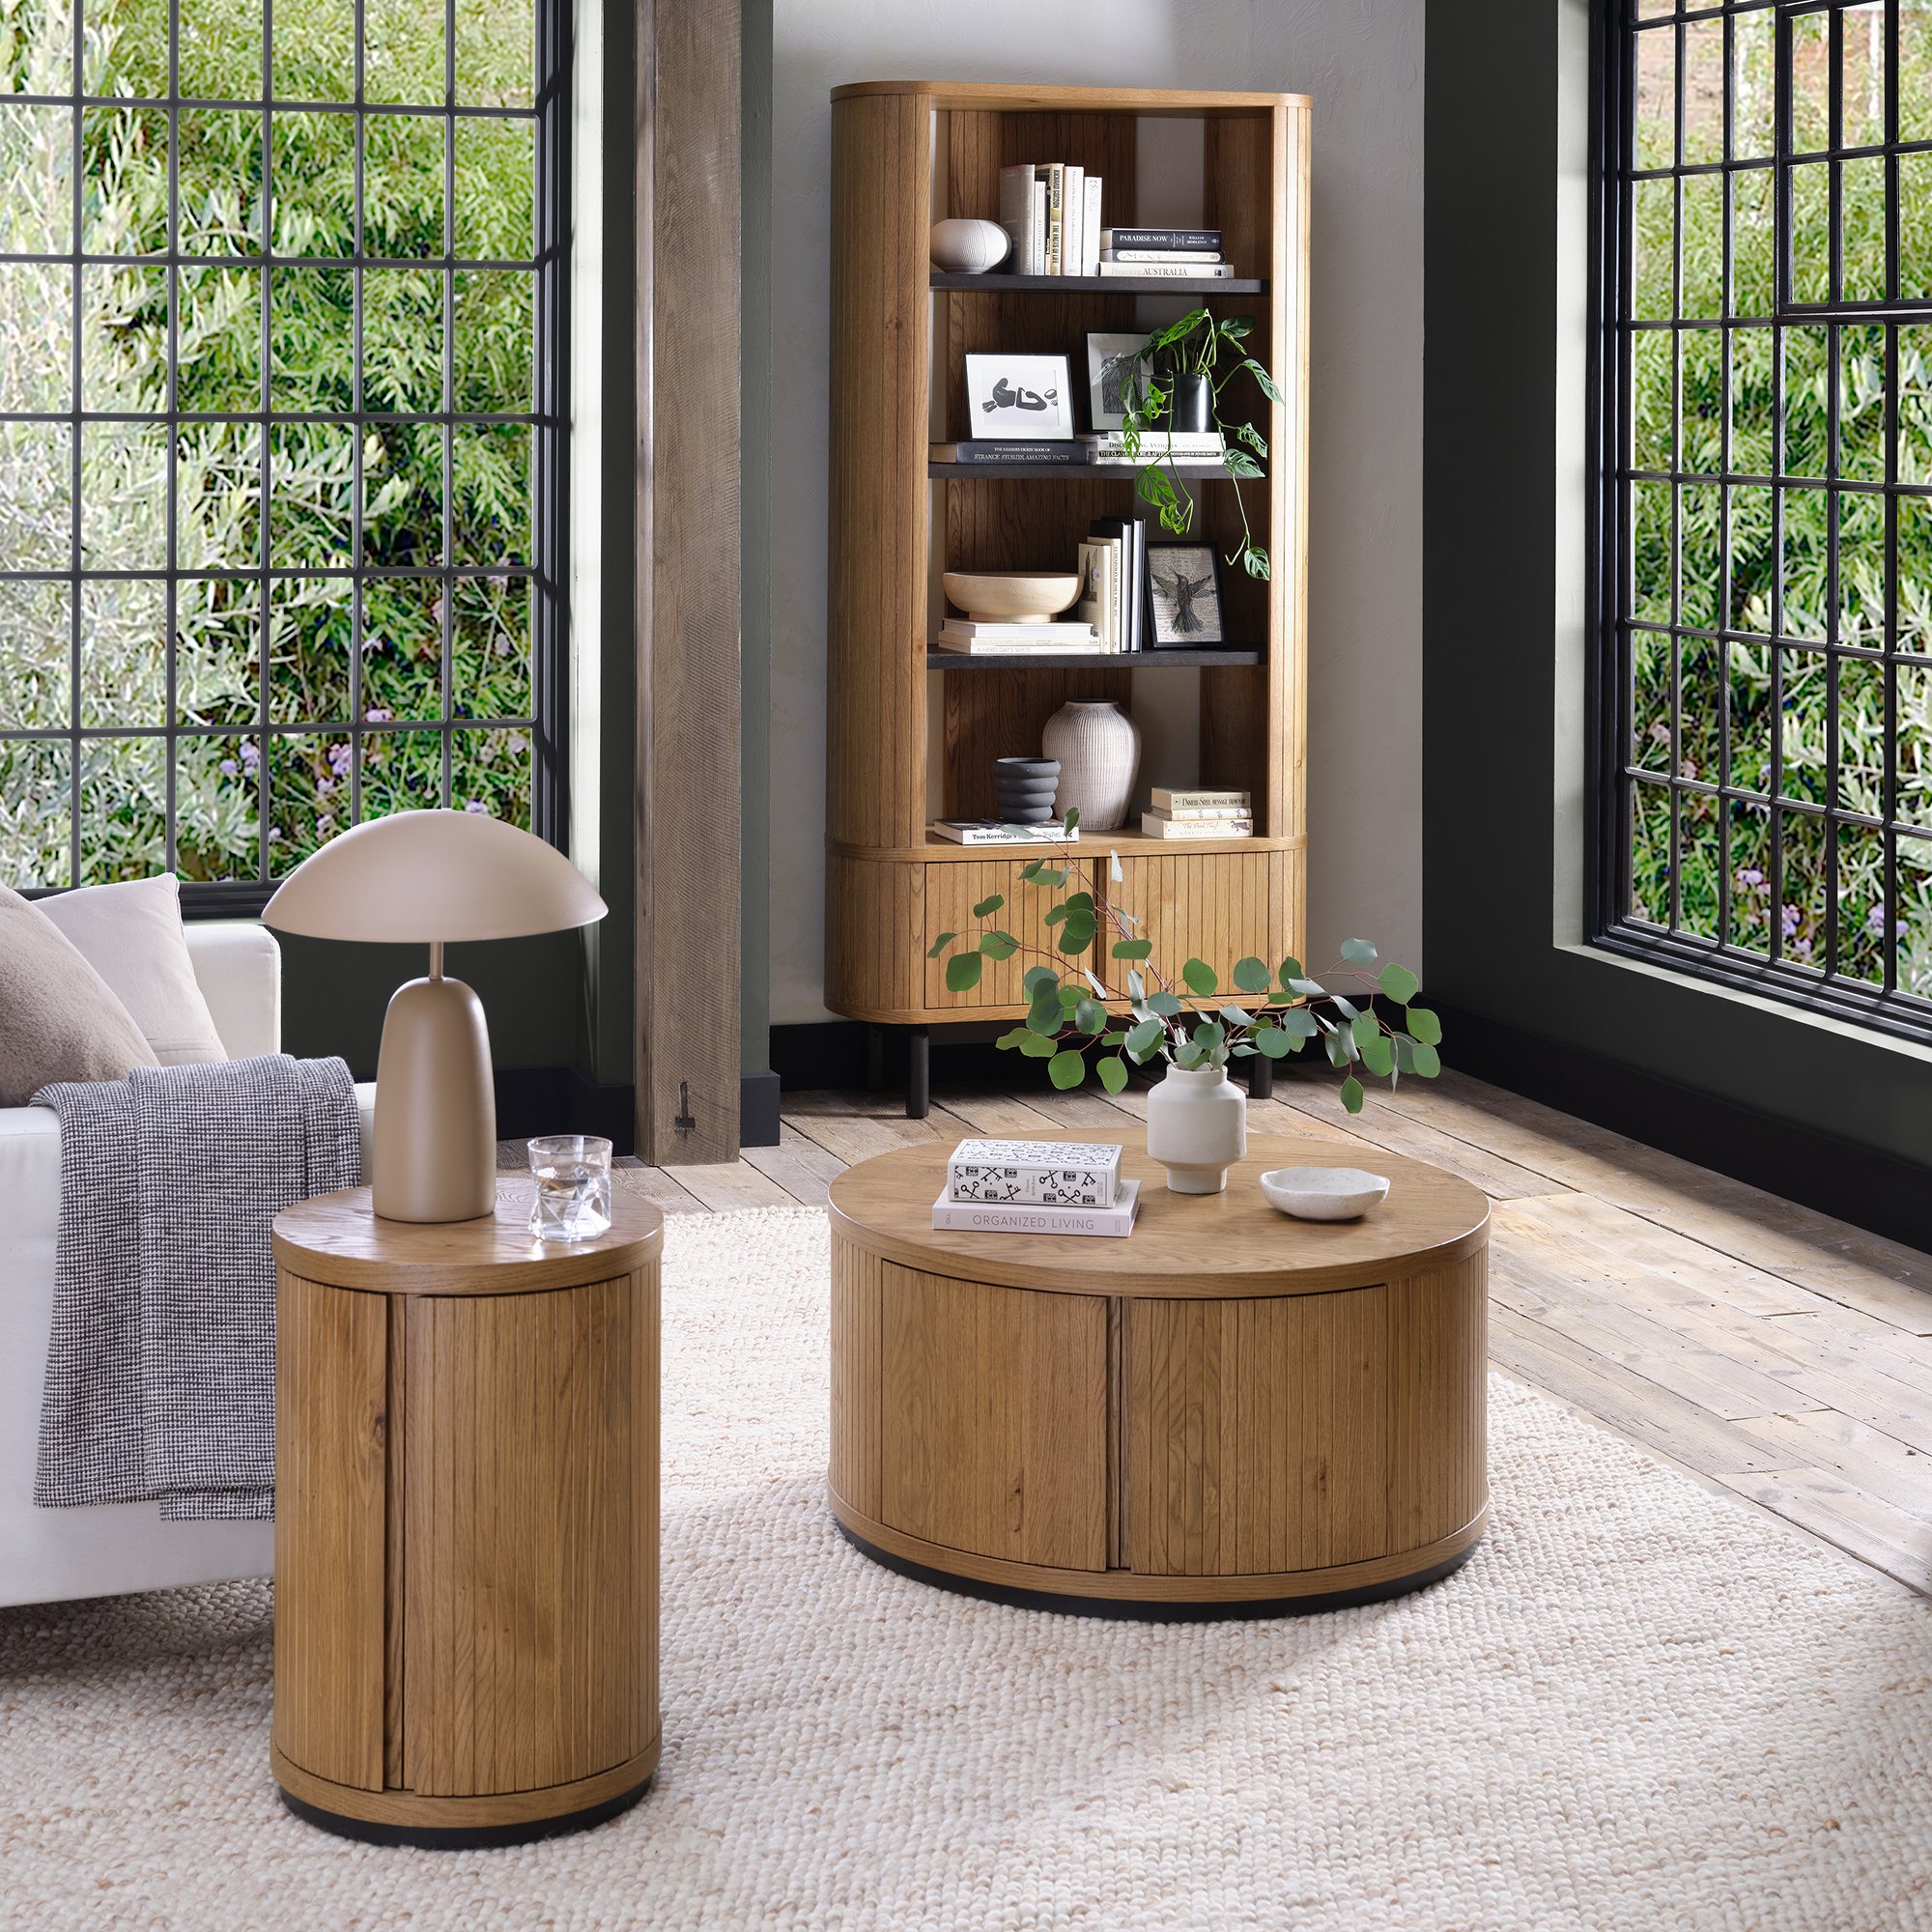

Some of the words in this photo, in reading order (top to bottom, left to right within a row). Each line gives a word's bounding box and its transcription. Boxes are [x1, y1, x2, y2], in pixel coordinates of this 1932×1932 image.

[1143, 268, 1187, 276] AUSTRALIA
[972, 1214, 1046, 1228] ORGANIZED
[1052, 1218, 1094, 1230] LIVING
